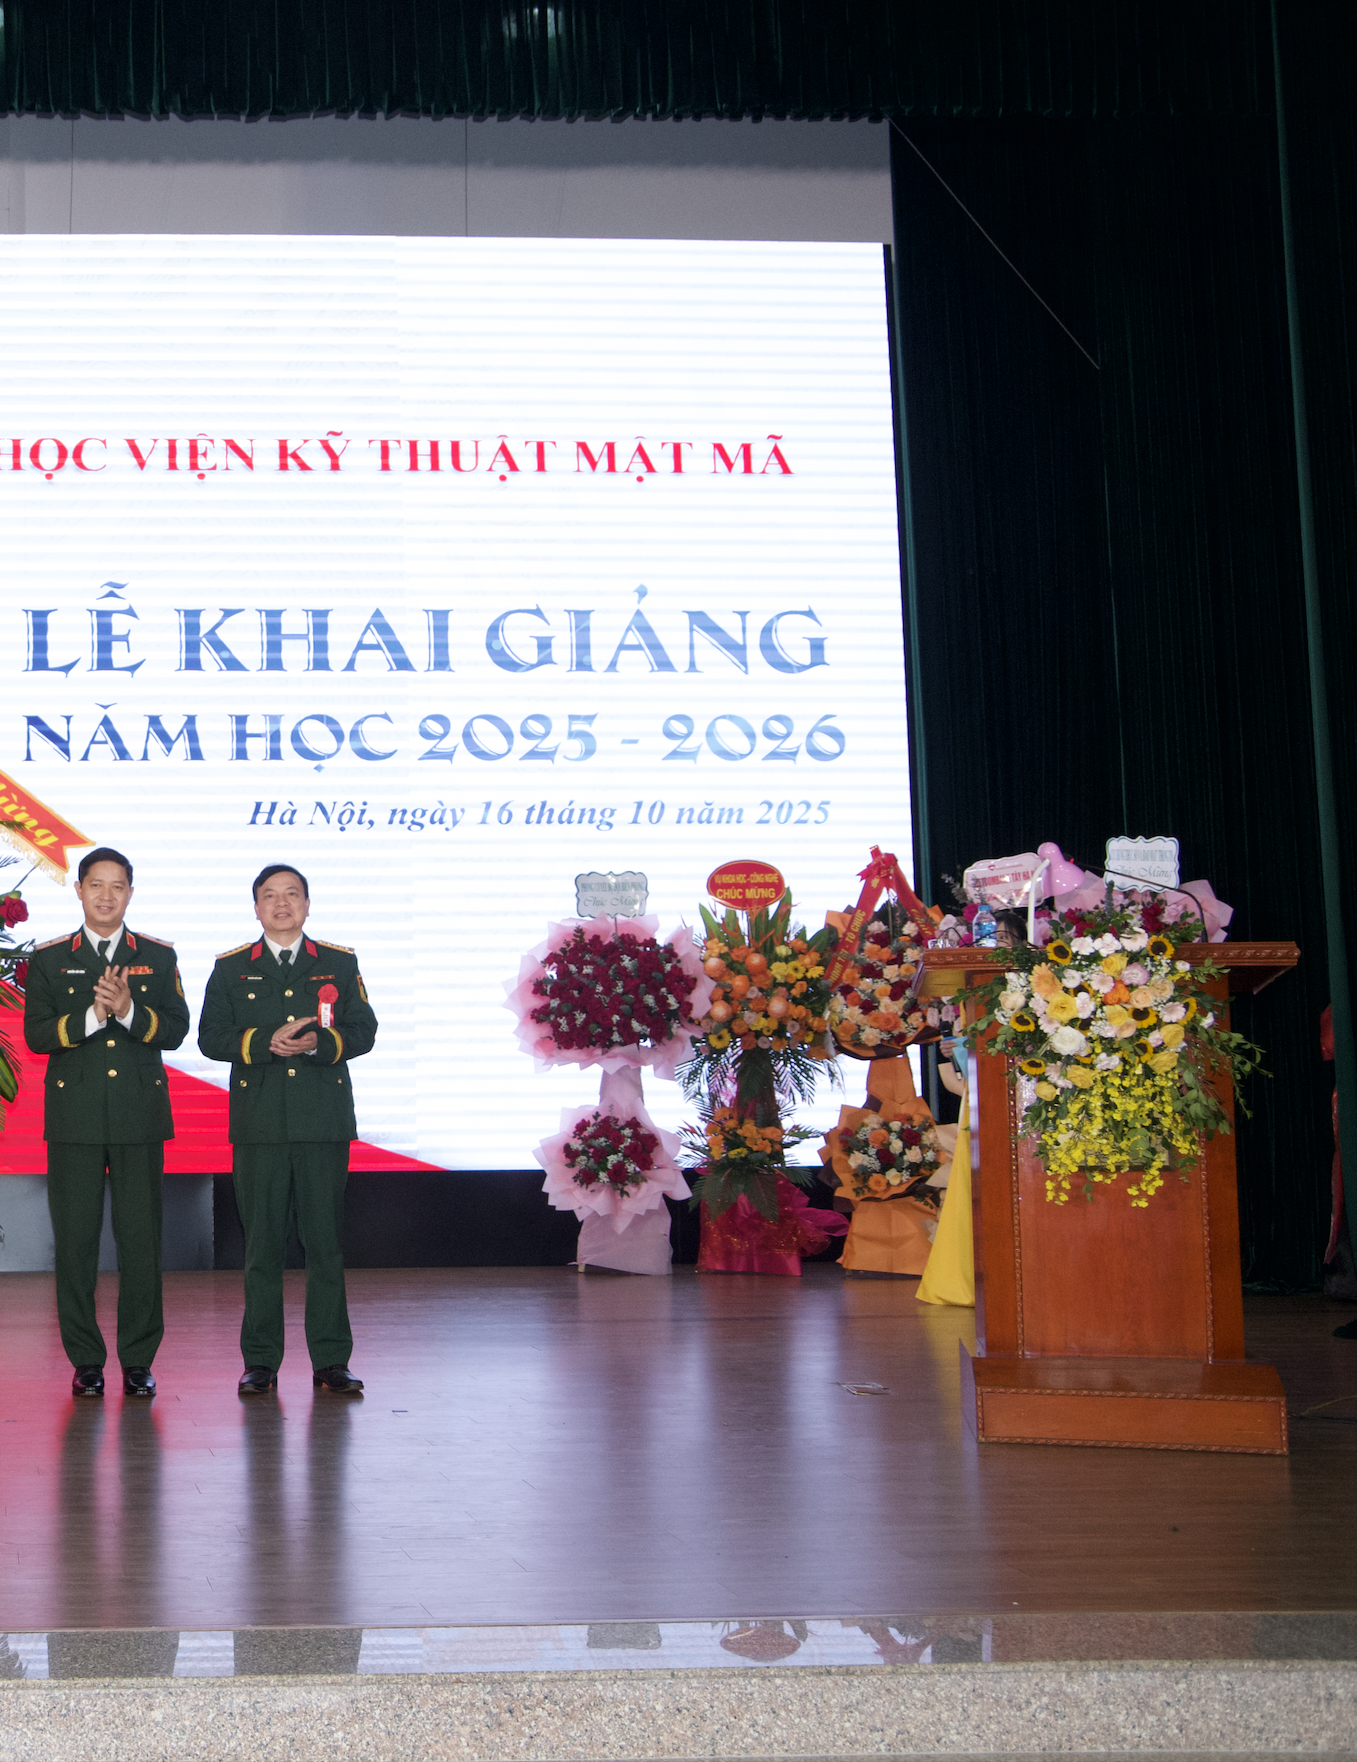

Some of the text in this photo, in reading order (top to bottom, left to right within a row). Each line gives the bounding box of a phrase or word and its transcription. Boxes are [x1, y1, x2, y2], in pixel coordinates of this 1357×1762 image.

[125, 434, 253, 481] VIỆN
[277, 430, 351, 472] KỸ
[368, 435, 556, 482] THUẬT
[575, 437, 692, 482] MẬT
[711, 434, 793, 475] MÃ
[21, 581, 831, 679] LỄ KHAI GIẢNG
[22, 703, 205, 763] NĂM
[227, 711, 399, 774] HỌC
[417, 712, 599, 765] 2025
[661, 713, 846, 765] 2026
[246, 799, 831, 832] Hà Nội, ngày 16 tháng 10 năm 2025
[716, 886, 776, 899] CHÚC MỪNG
